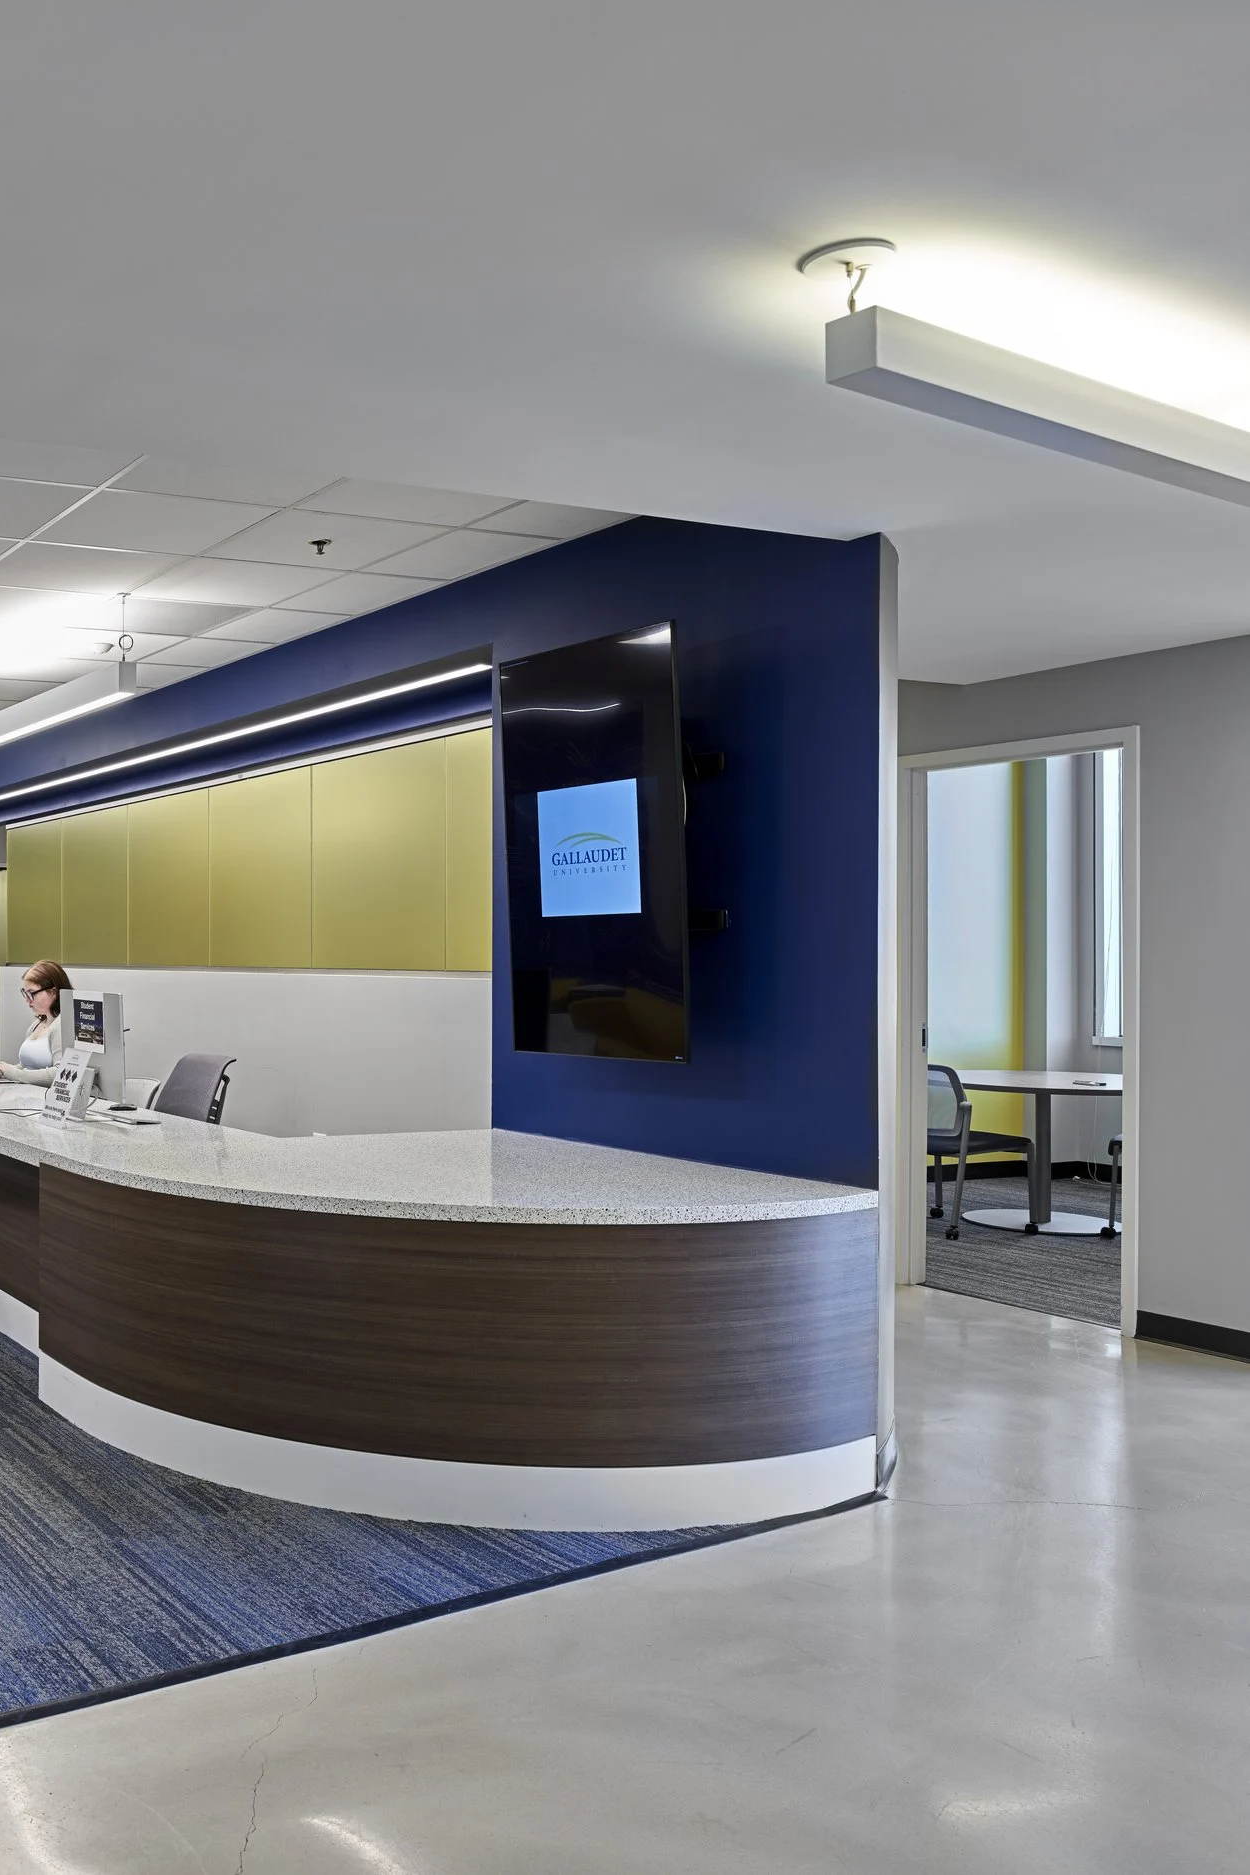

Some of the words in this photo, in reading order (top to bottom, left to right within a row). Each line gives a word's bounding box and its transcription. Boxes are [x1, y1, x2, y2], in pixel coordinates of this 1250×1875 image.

[552, 847, 627, 866] GALLAUDET
[553, 865, 627, 876] UNIVERSITY
[80, 1001, 94, 1010] Student
[79, 1011, 95, 1021] Financial
[80, 1022, 95, 1031] Services
[54, 1088, 70, 1096] FINANCIAL
[56, 1095, 71, 1103] SERVICES
